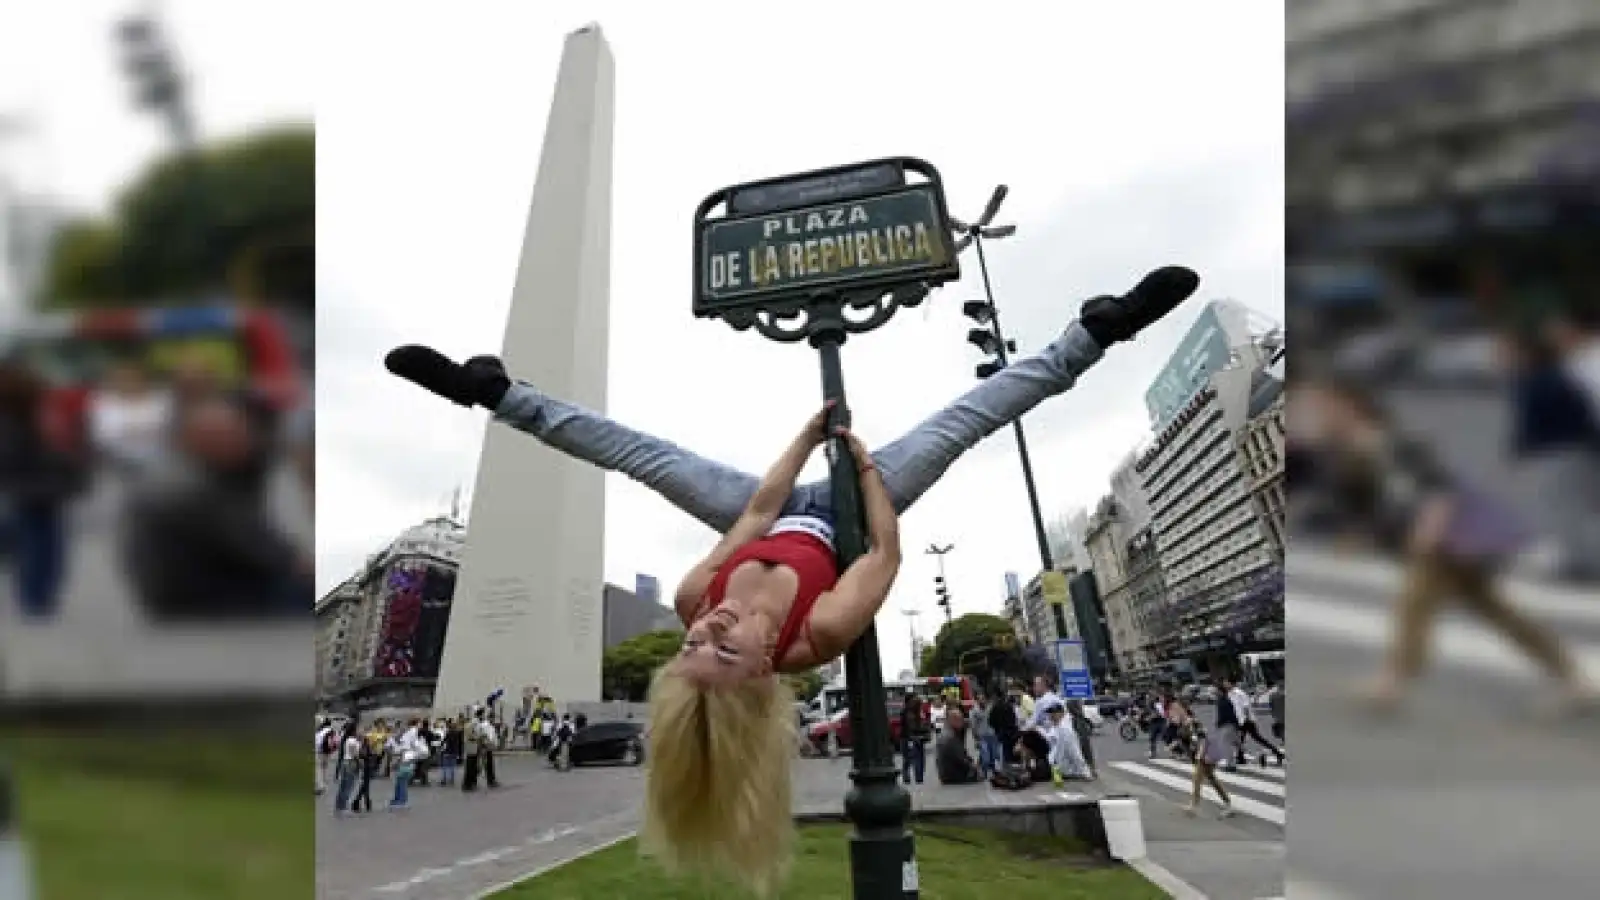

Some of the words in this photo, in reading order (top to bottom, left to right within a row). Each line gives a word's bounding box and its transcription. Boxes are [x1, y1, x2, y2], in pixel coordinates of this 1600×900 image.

[763, 206, 869, 237] PLAZA
[710, 251, 742, 288] DE
[749, 246, 781, 283] LA
[789, 222, 932, 278] REPUBLICA
